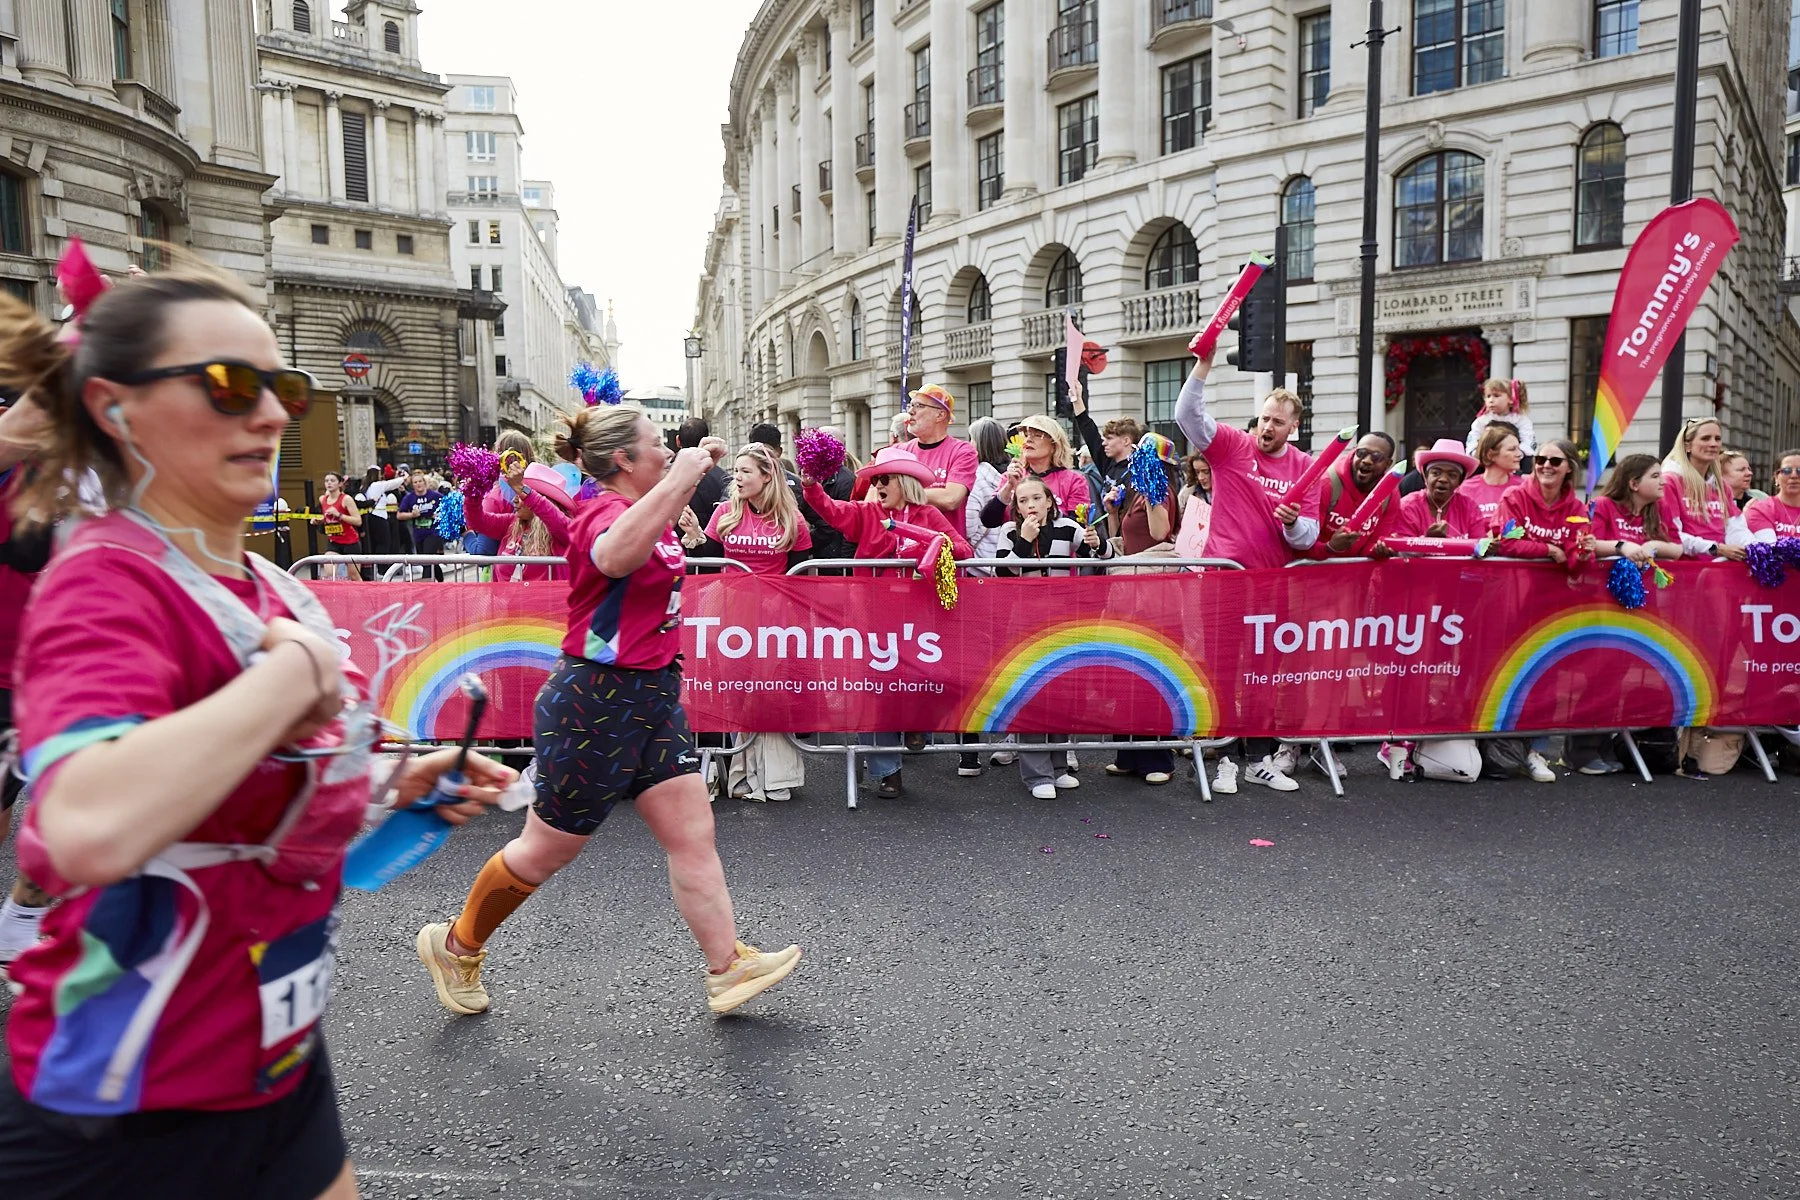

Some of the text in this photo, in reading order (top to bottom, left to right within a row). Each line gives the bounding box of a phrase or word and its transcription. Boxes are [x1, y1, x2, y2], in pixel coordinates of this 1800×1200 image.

[1383, 288, 1504, 310] LOMBARD STREET
[1616, 231, 1701, 358] Tommy's
[1639, 240, 1716, 369] The pregnancy and baby charity
[1215, 296, 1244, 329] Tommy's
[683, 616, 943, 672] Tommy's
[1243, 605, 1464, 656] Tommy's
[1243, 661, 1461, 686] The pregnancy and baby charity
[1743, 659, 1768, 673] The
[683, 678, 944, 694] The pregnancy and baby charity
